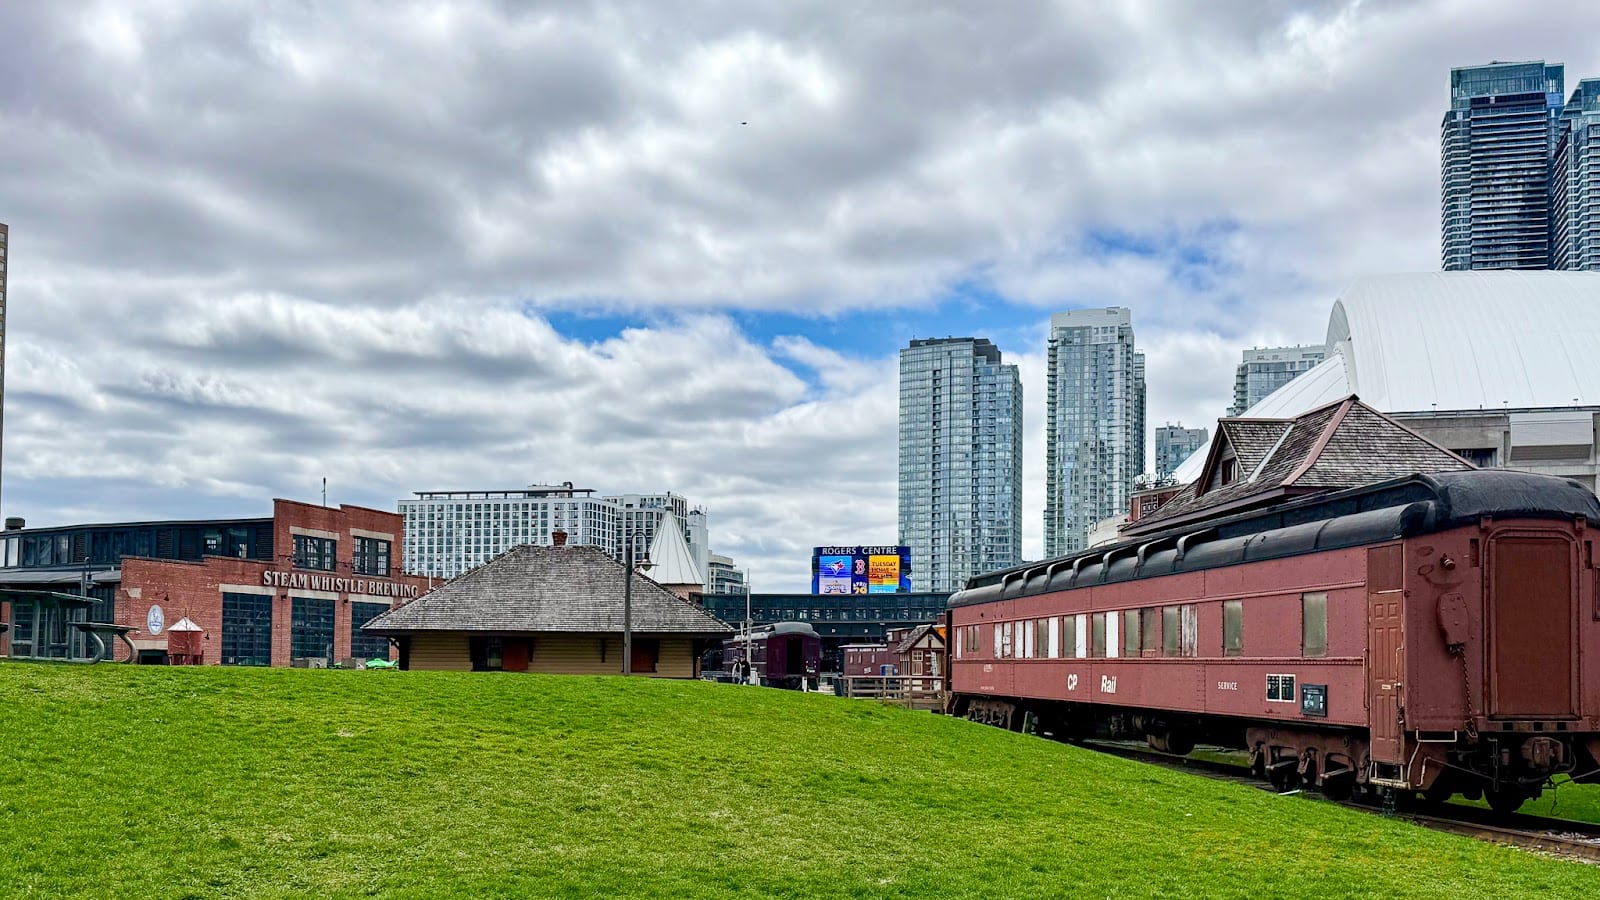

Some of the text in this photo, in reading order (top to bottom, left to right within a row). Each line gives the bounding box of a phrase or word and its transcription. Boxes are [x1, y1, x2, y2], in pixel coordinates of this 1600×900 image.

[822, 546, 897, 555] ROGERS CENTRE
[263, 570, 418, 598] STEAM WHISTLE BREWING
[1067, 673, 1117, 694] CP Rail
[1217, 681, 1238, 691] SERVICE
